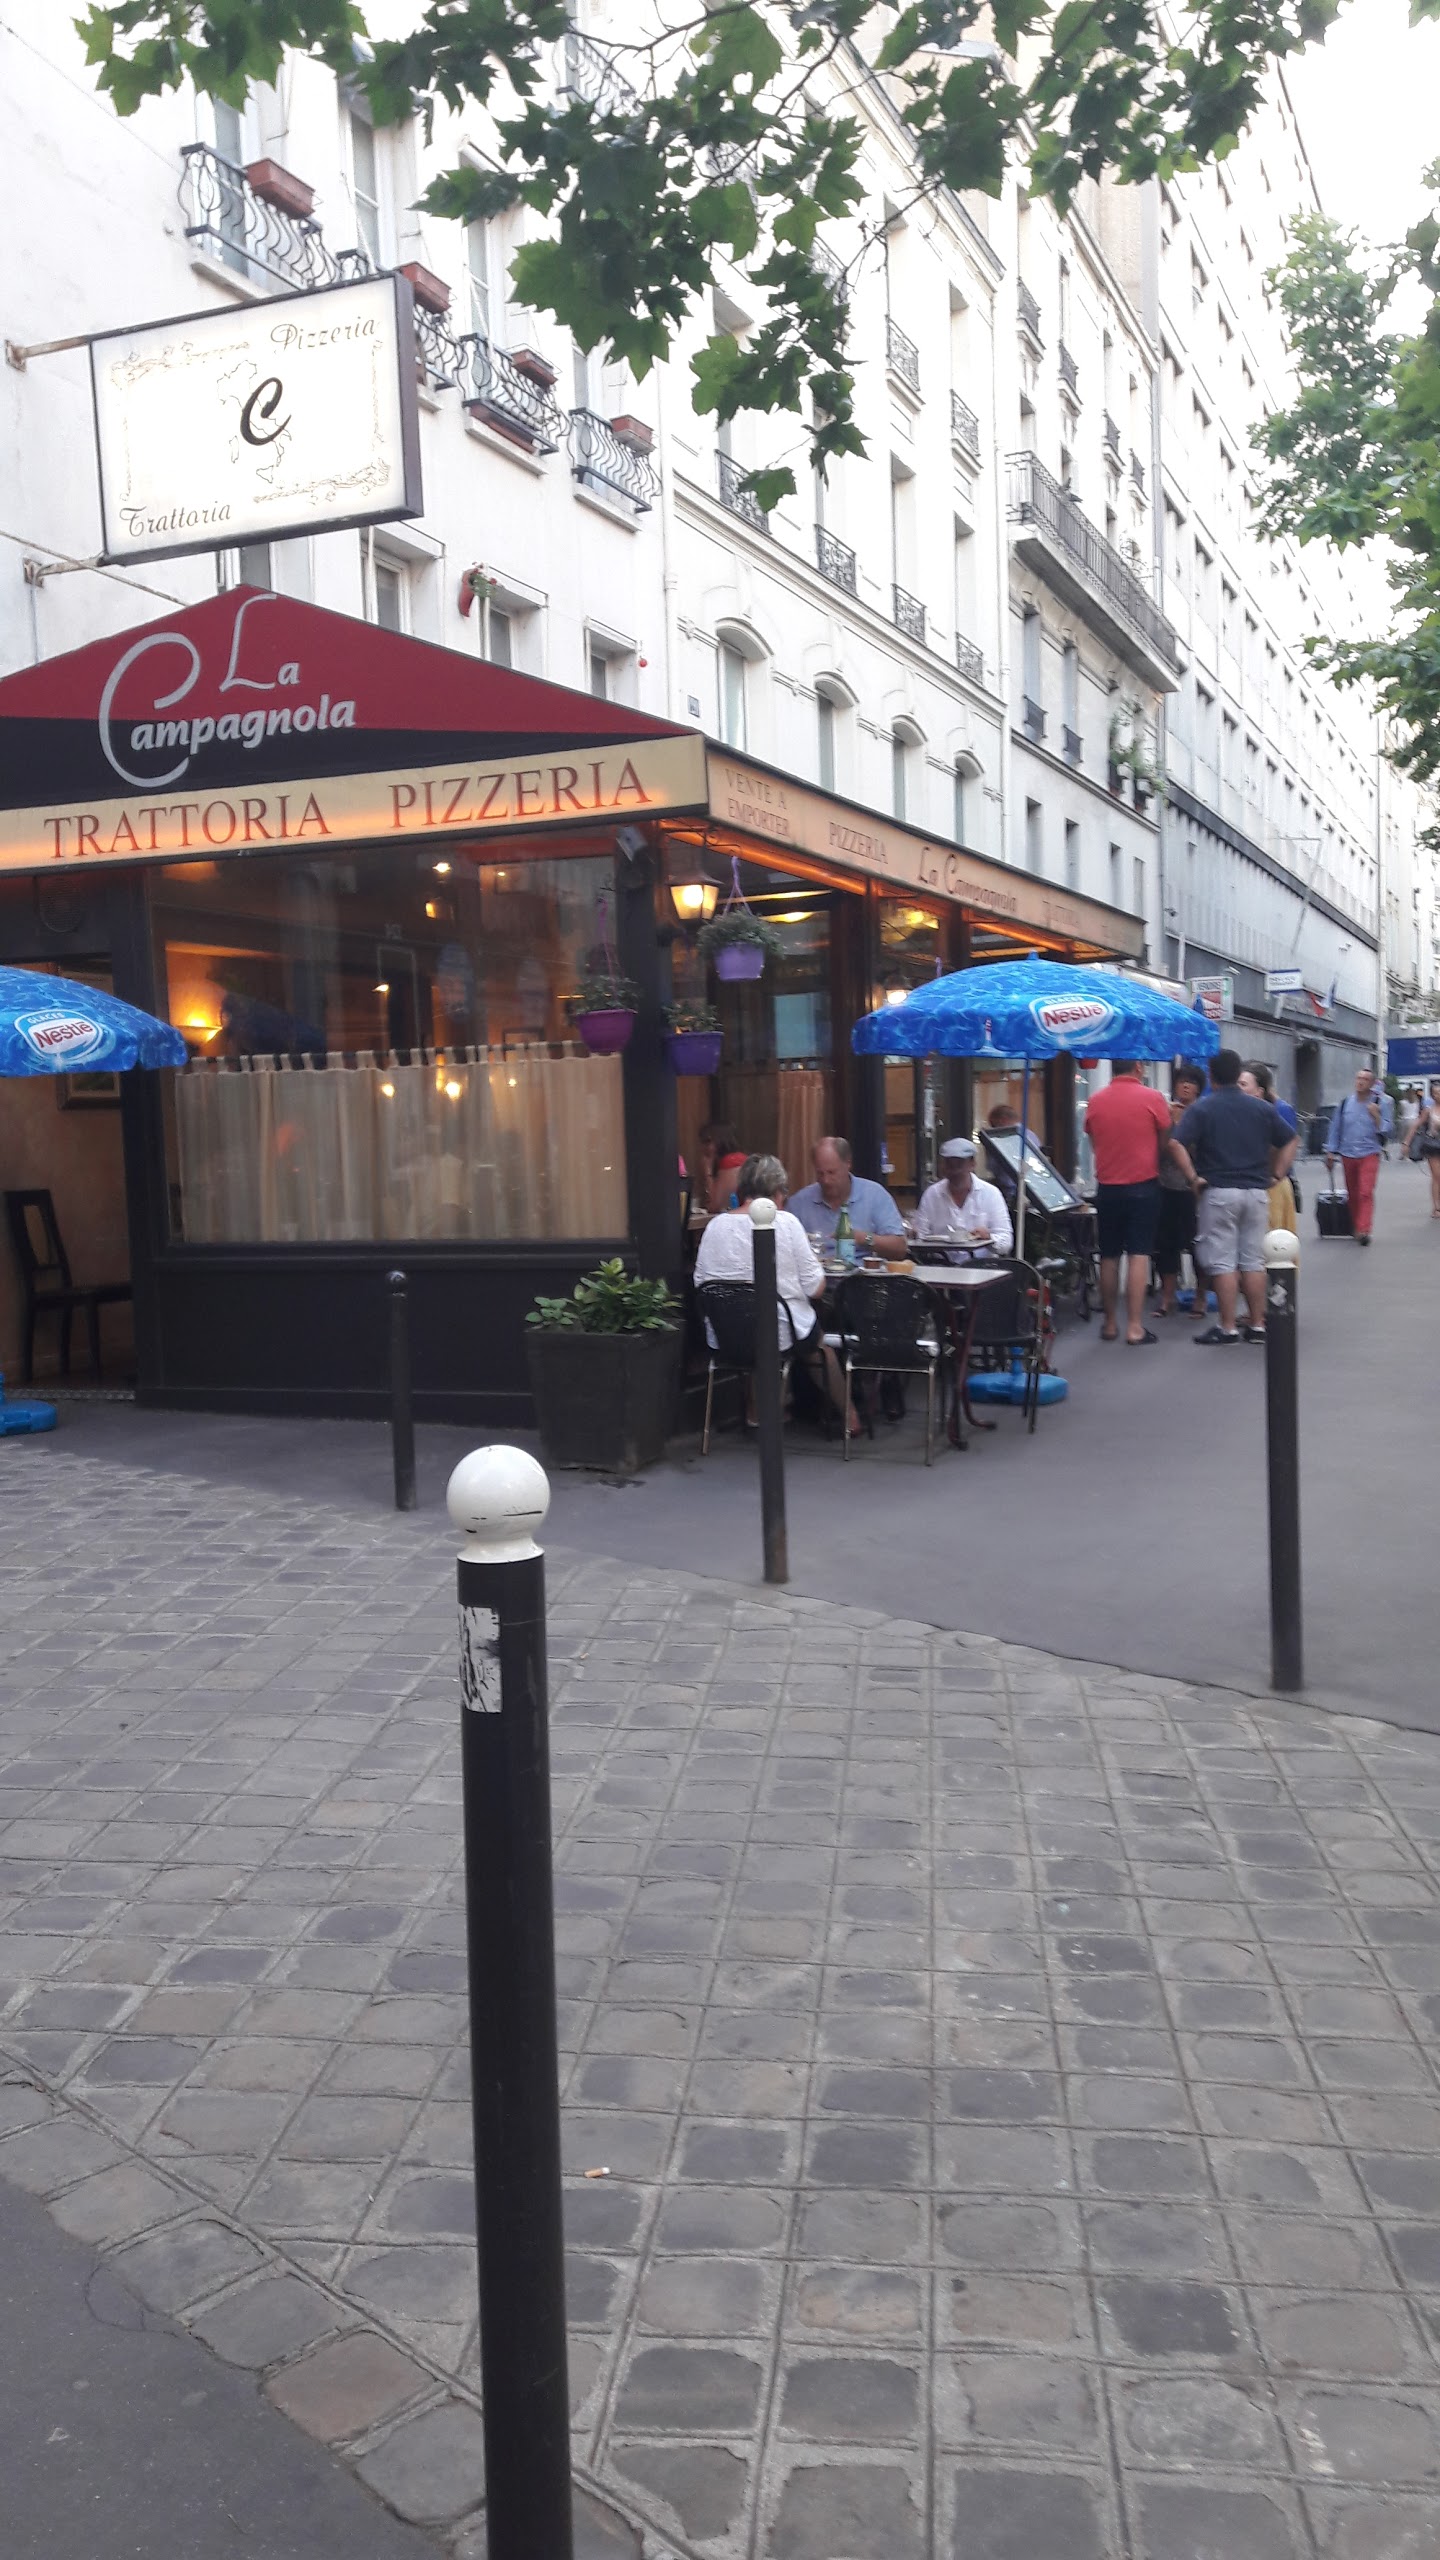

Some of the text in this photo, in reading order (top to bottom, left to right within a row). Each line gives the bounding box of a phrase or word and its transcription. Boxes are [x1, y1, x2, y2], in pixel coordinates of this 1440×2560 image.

[270, 316, 377, 350] Pizzeria
[240, 376, 292, 446] C
[119, 500, 232, 537] Trattoria
[219, 593, 301, 693] La
[98, 631, 356, 788] Campagnola
[725, 768, 771, 804] VENTE
[43, 757, 653, 860] TRATTORIA PIZZERIA
[727, 797, 790, 837] EMPORTER
[829, 821, 889, 865] PIZZERIA
